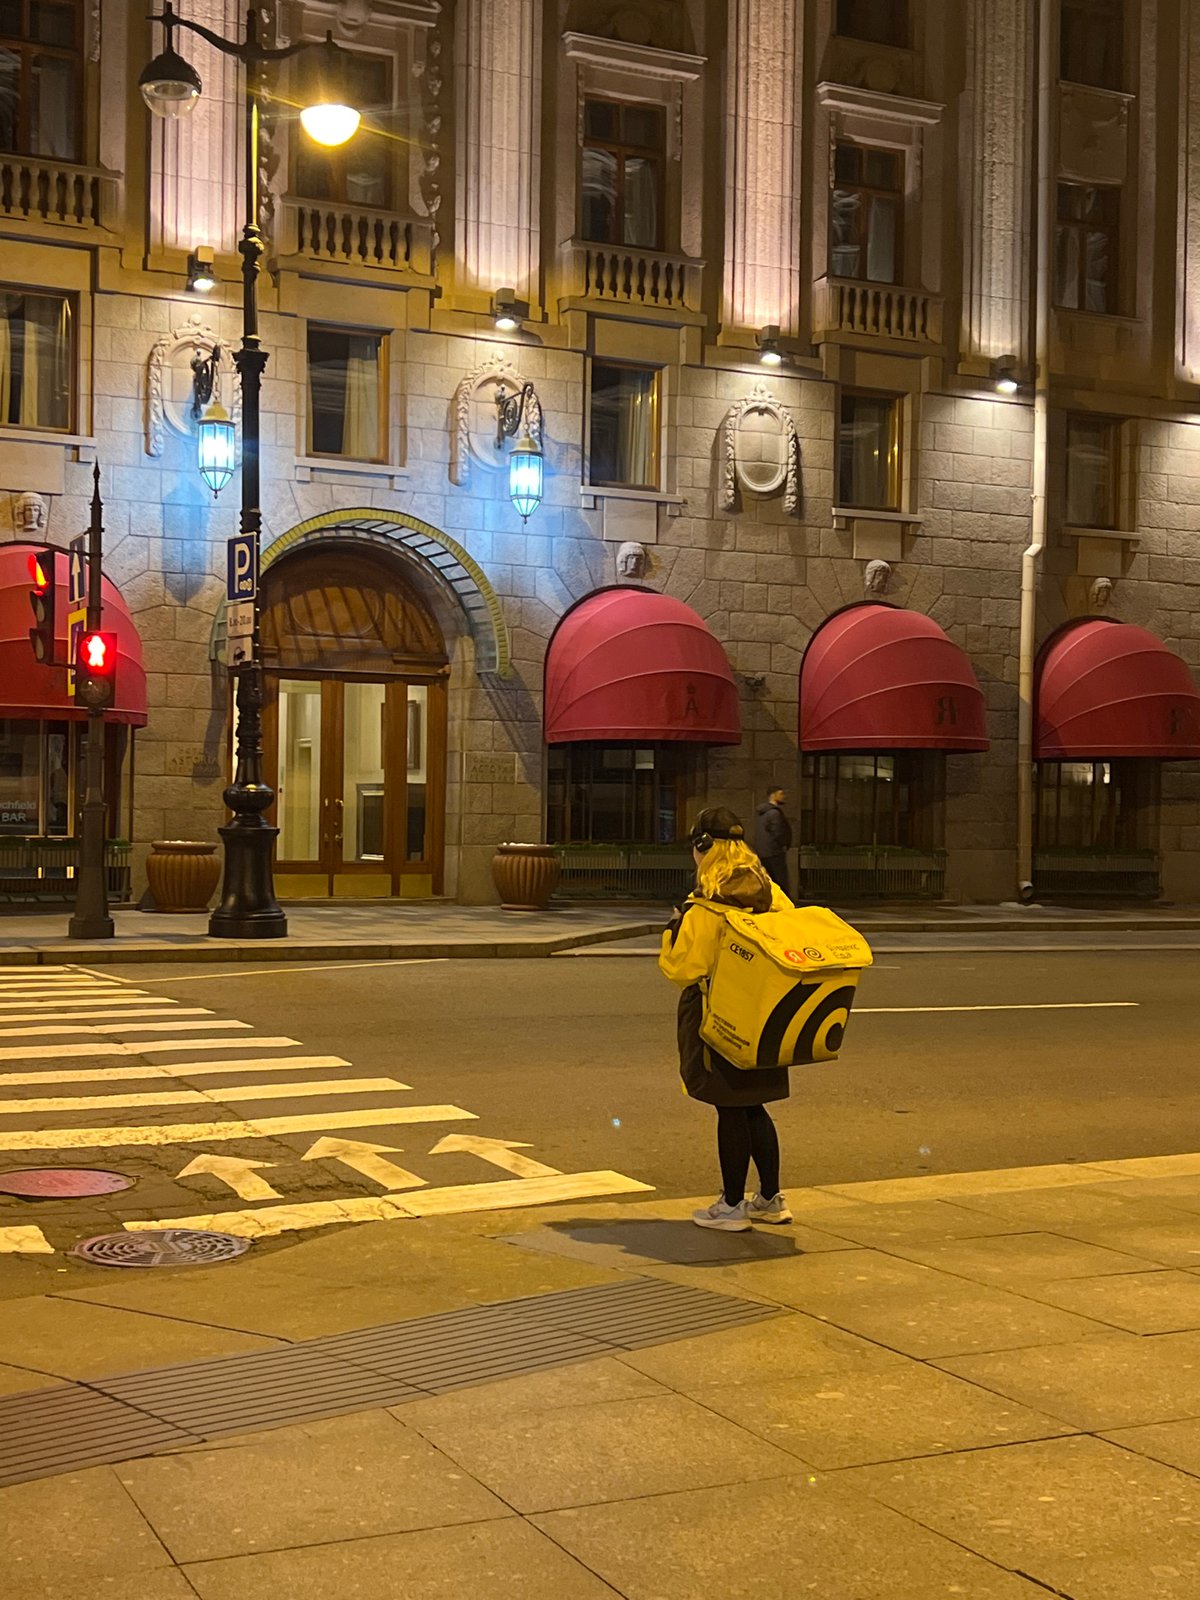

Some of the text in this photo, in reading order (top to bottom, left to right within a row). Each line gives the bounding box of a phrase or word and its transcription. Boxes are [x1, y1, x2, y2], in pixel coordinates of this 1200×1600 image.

[234, 542, 251, 594] P
[0, 800, 37, 810] chfield
[1, 812, 26, 822] BAR
[729, 942, 755, 962] CE1857
